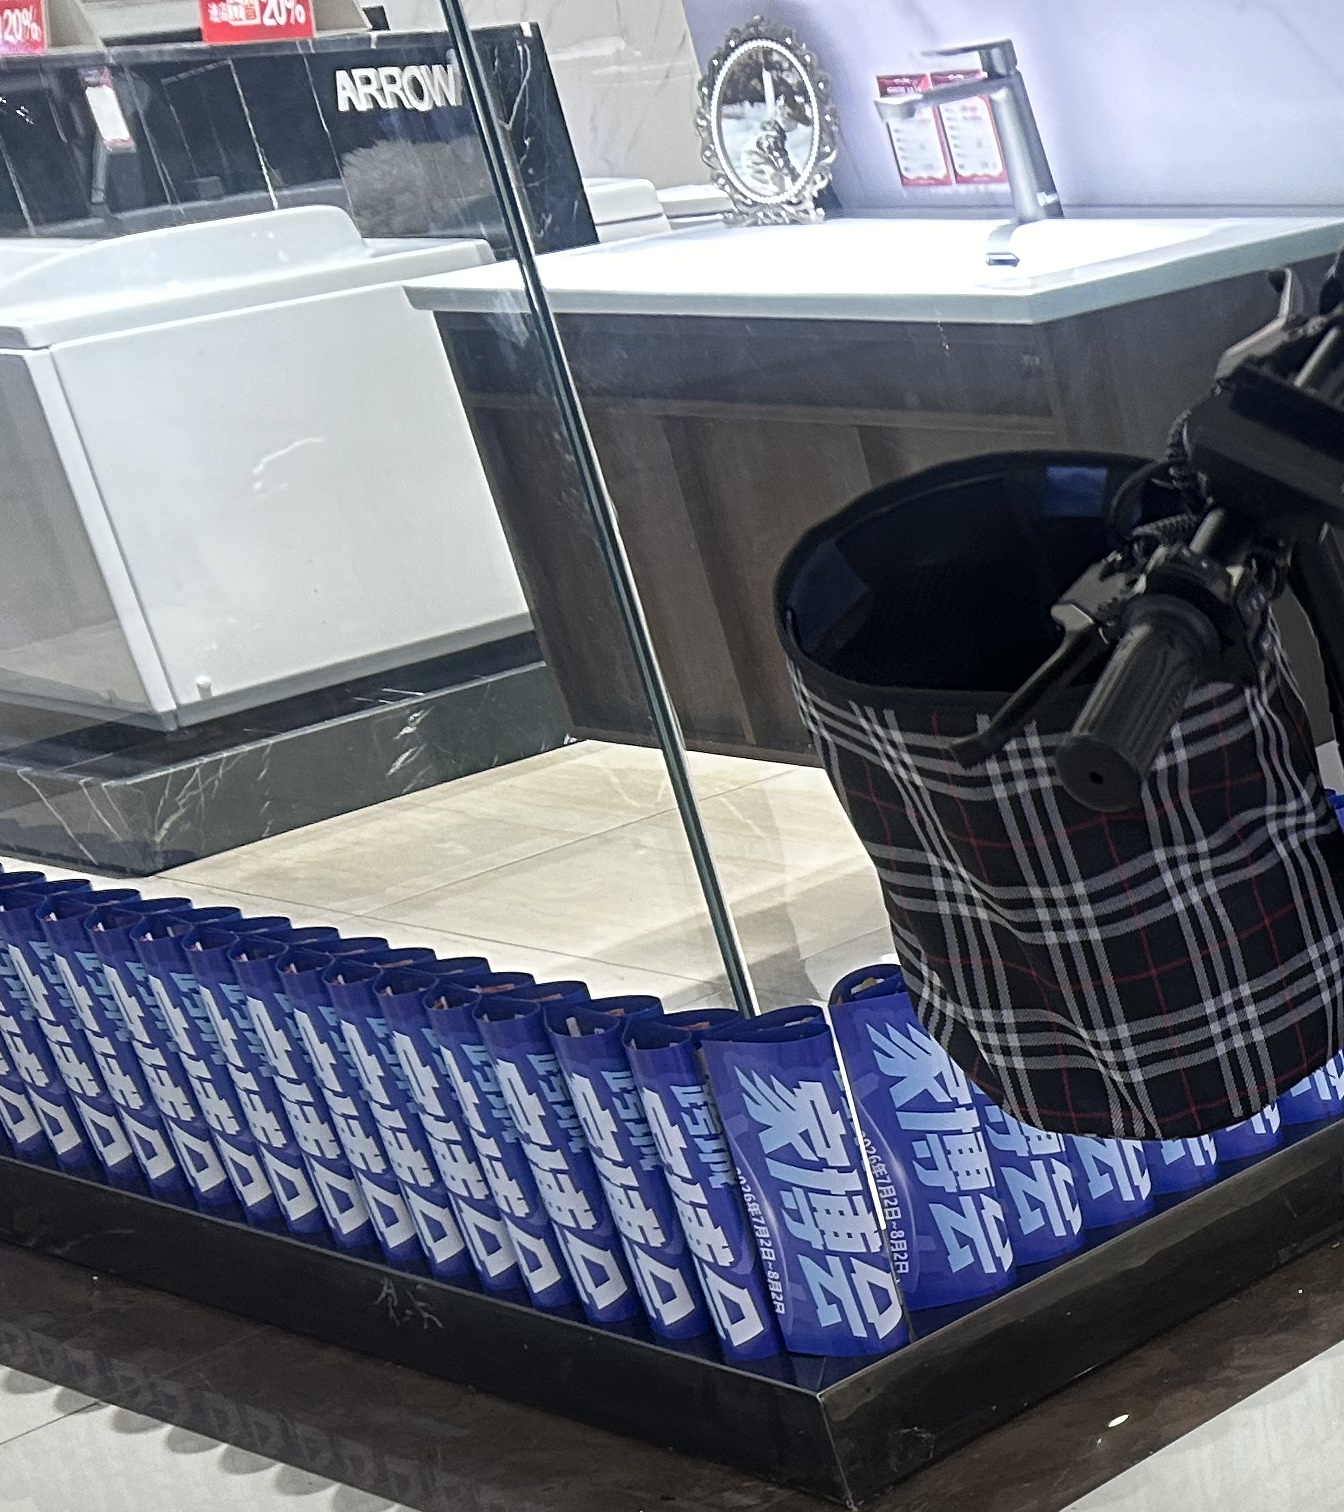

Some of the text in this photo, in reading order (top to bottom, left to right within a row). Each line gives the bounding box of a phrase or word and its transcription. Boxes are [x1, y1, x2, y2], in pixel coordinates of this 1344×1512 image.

[335, 64, 463, 112] ARROW
[734, 1064, 902, 1340] 家博会
[860, 1130, 910, 1275] 026年7月2日~8月2日
[868, 1020, 1014, 1275] 家博会
[735, 1167, 787, 1316] 026年7月2日~8月2日
